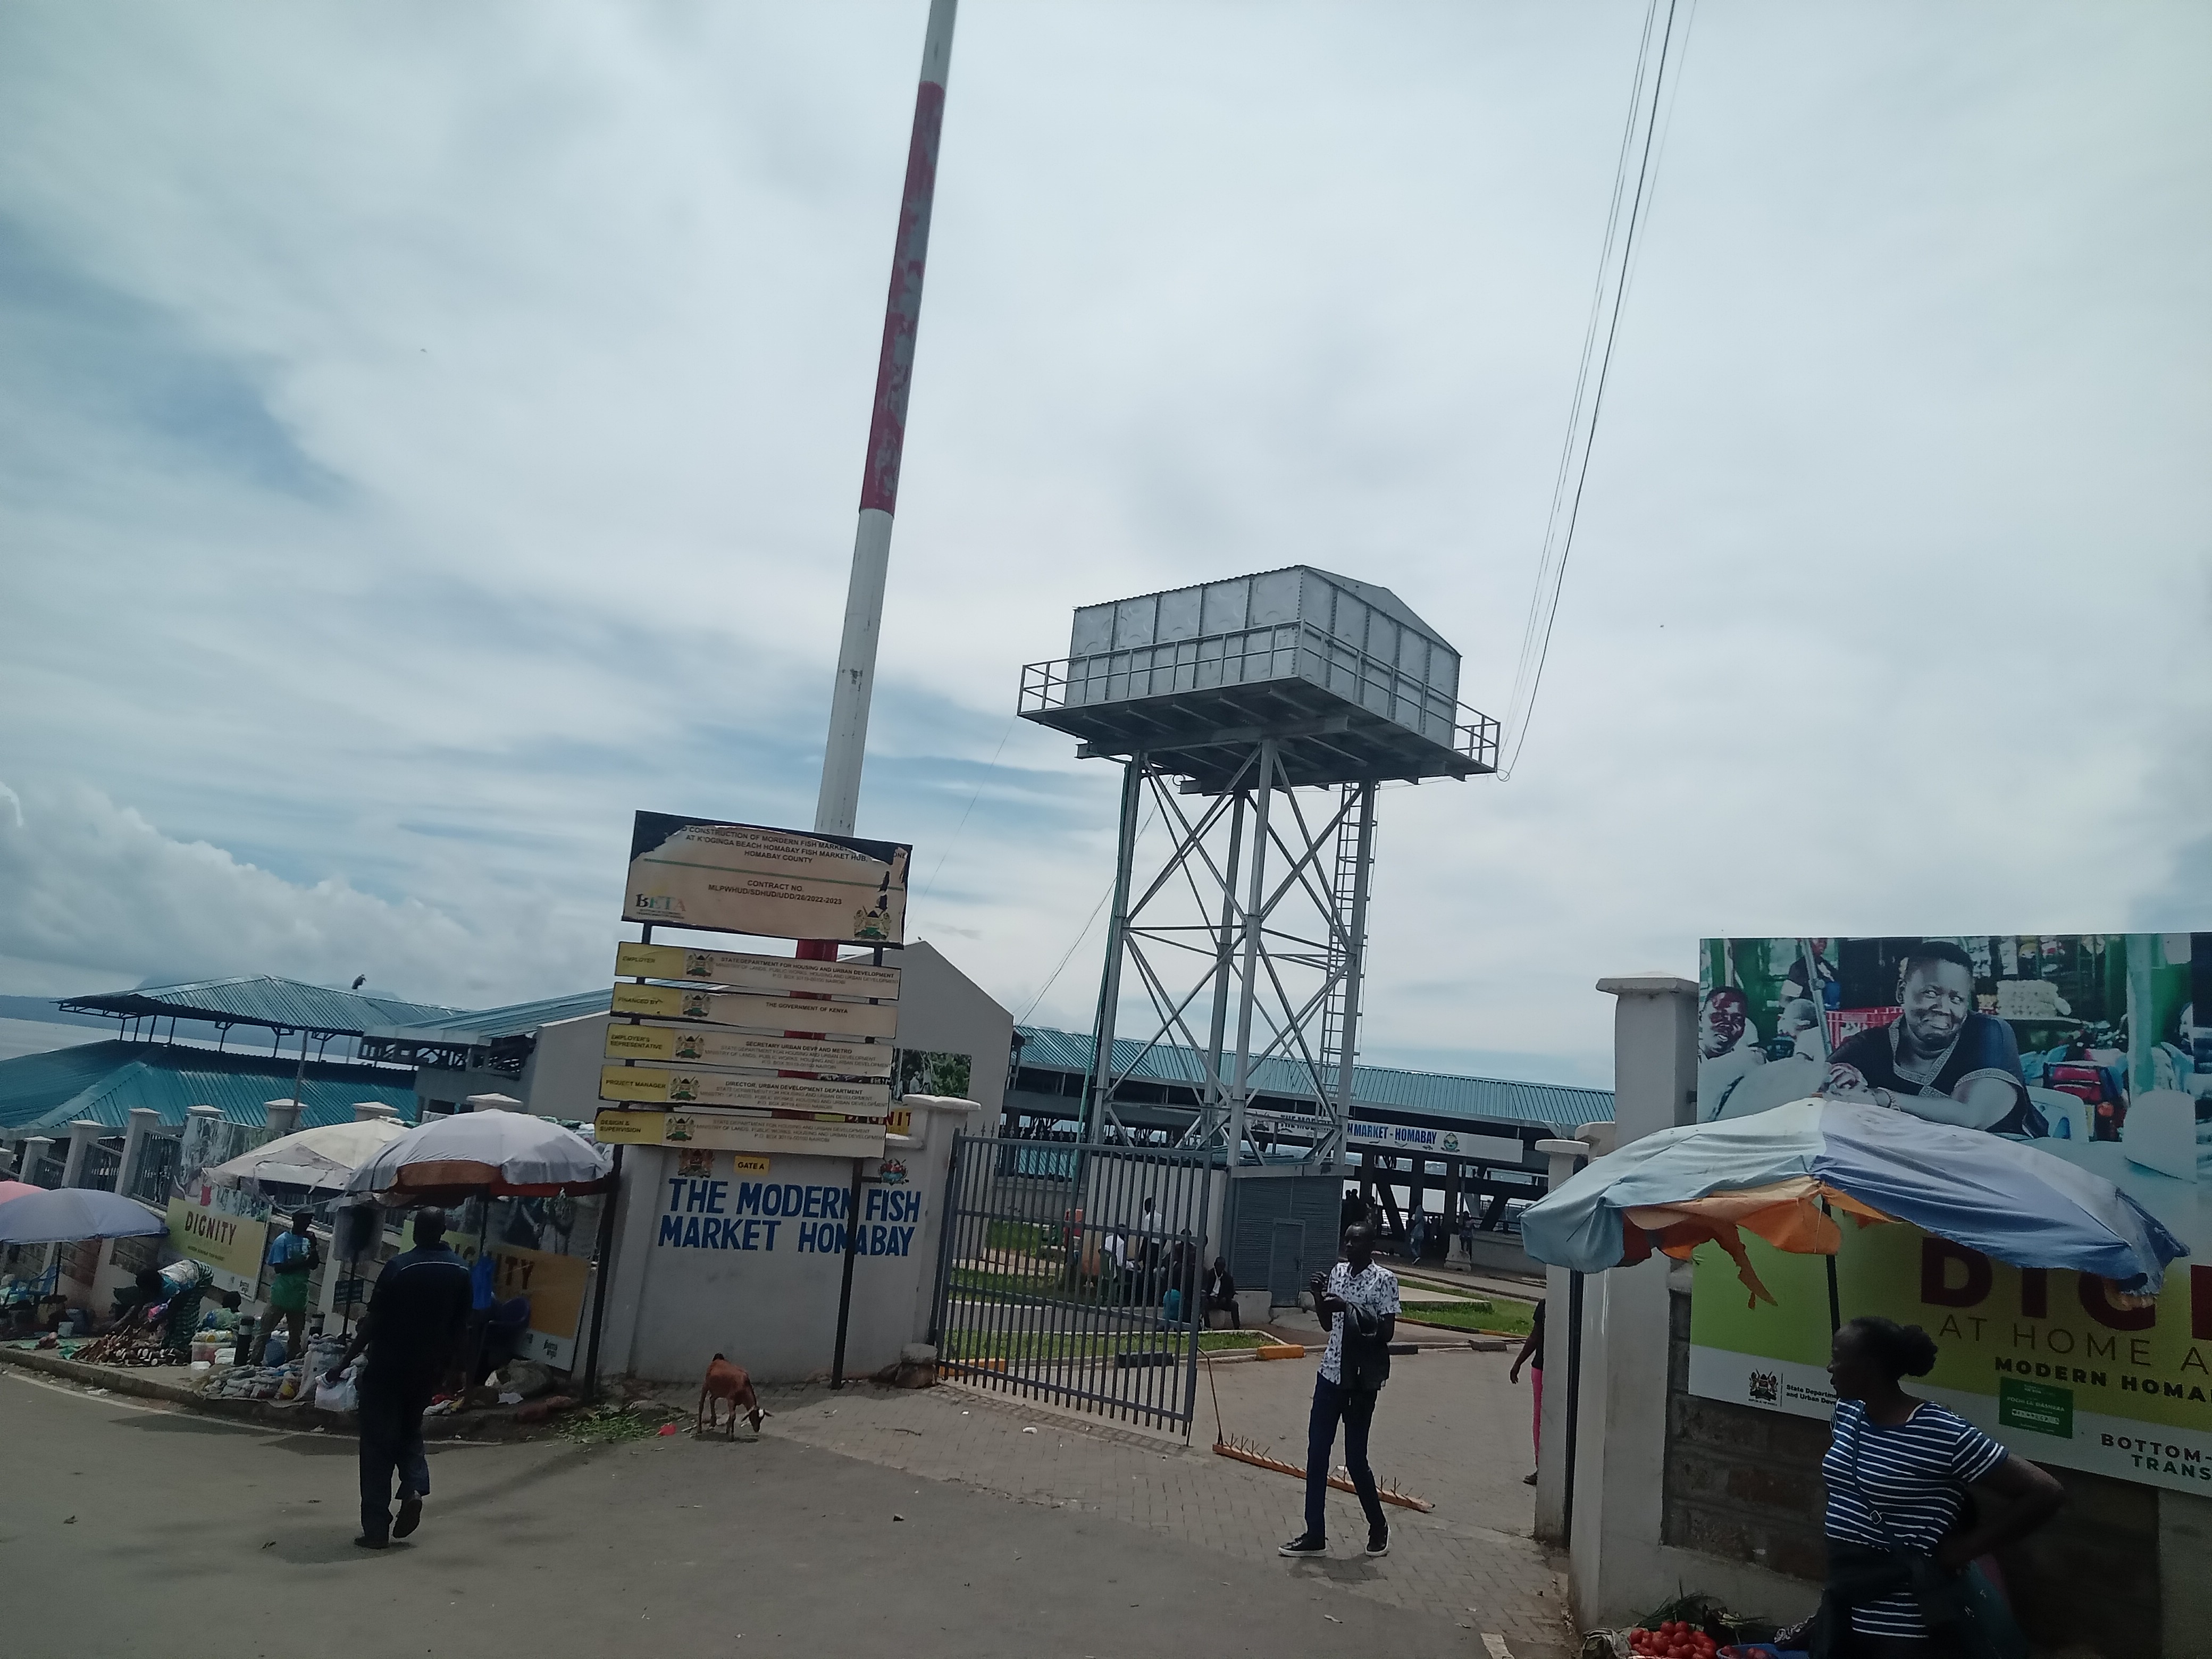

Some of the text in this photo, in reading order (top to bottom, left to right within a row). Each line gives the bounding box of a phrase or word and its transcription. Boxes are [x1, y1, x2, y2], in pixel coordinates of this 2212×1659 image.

[690, 826, 748, 839] CONSTRUCTION
[762, 836, 798, 845] MORDERN
[736, 841, 761, 849] BEACH
[763, 844, 801, 853] HOMABAY
[819, 851, 849, 860] MARKET
[744, 850, 813, 863] HOMABAY COUNTY
[748, 880, 789, 891] CONTRACT
[610, 1041, 663, 1050] REPRESENTATIVE
[1354, 1123, 1389, 1140] MARKET
[1395, 1128, 1437, 1145] HOMABAY
[738, 1161, 765, 1170] GATE A
[668, 1178, 921, 1223] THE MODERN FISH
[185, 1211, 237, 1245] DIGNITY
[658, 1214, 915, 1257] MARKET HOMABAY
[1939, 1314, 1987, 1341] AT
[2013, 1323, 2151, 1366] HOME
[1786, 1384, 1804, 1393] State
[1995, 1356, 2212, 1403] MODERN HOMA
[1800, 1394, 1819, 1402] Urban
